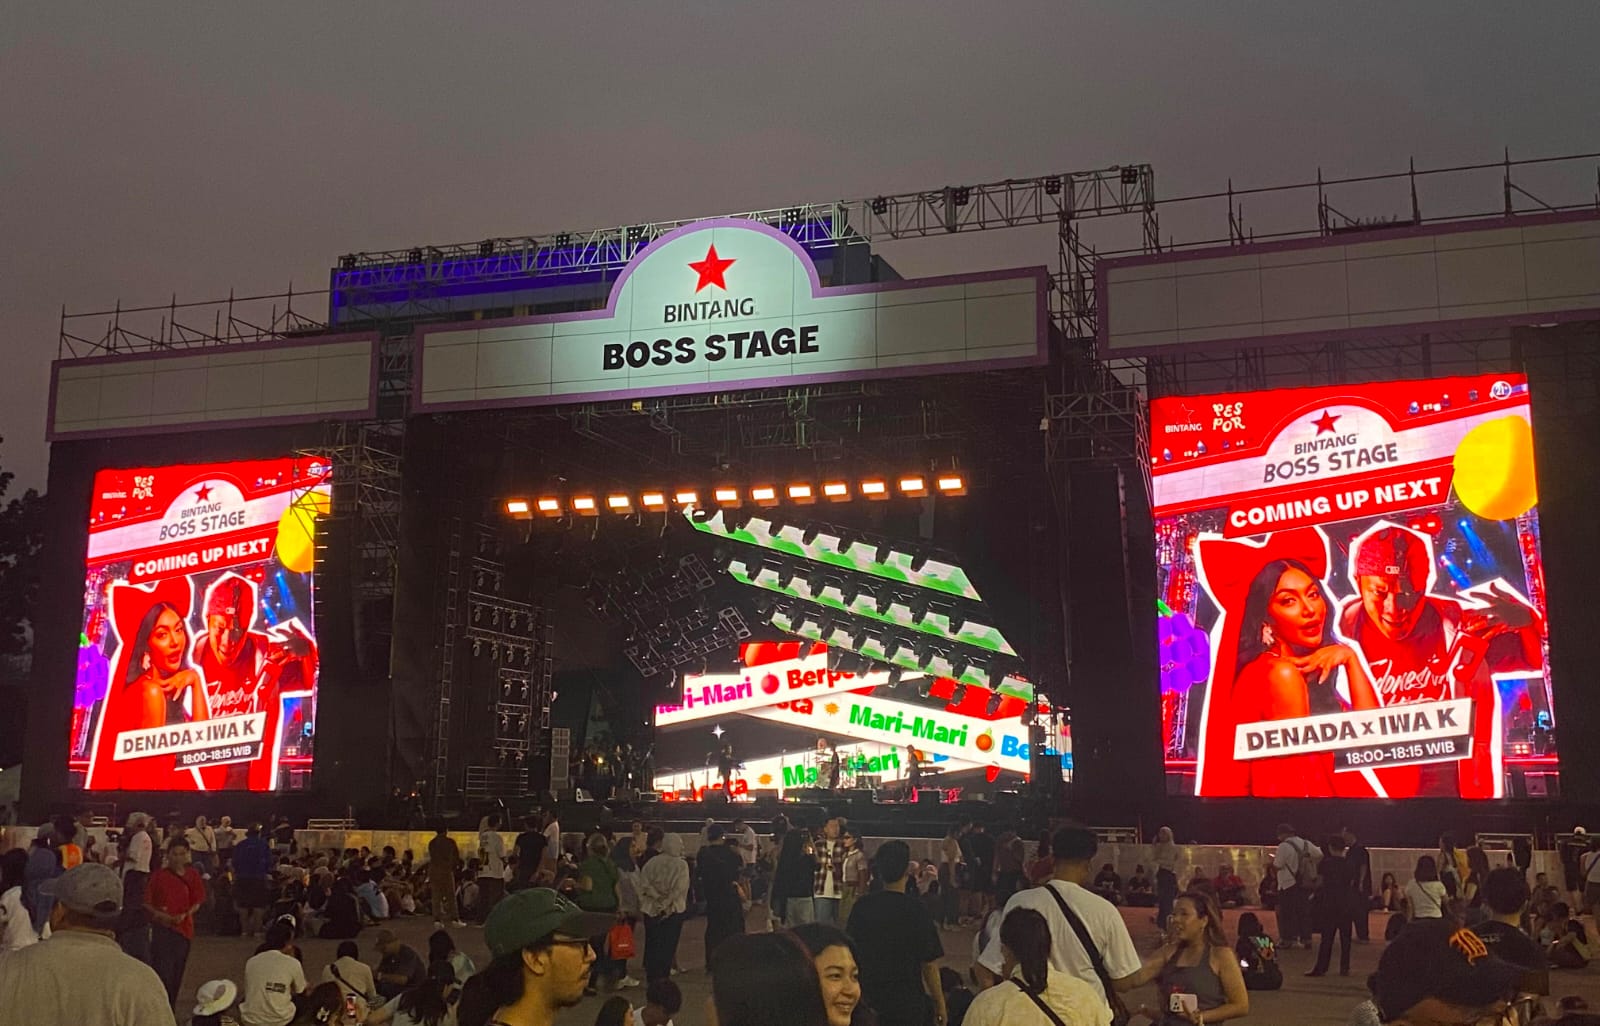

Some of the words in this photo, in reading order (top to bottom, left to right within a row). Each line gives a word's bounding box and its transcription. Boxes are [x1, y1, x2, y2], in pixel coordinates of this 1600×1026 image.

[664, 298, 755, 323] BINTANG
[603, 337, 696, 371] BOSS
[704, 325, 819, 362] STAGE
[1212, 402, 1244, 418] PES
[1165, 423, 1203, 433] BINTANG
[1212, 417, 1246, 432] POR
[1294, 433, 1357, 455] BINTANG
[1263, 456, 1320, 483] BOSS
[1329, 442, 1398, 471] STAGE
[132, 487, 154, 500] POR
[1230, 498, 1330, 528] COMING
[1336, 489, 1370, 511] UP
[1375, 477, 1441, 500] NEXT
[180, 502, 222, 519] BINTANG
[159, 523, 196, 541] BOSS
[201, 510, 245, 532] STAGE
[134, 552, 198, 576] COMING
[202, 547, 224, 563] UP
[226, 538, 270, 559] NEXT
[123, 731, 192, 754] DENADA
[206, 721, 239, 741] IWA
[242, 719, 256, 735] K
[849, 704, 969, 747] Mari-Mari
[1246, 720, 1357, 751] DENADA
[1378, 710, 1432, 736] IWA
[1437, 707, 1458, 729] K
[232, 746, 252, 757] WIB
[1427, 741, 1456, 756] WIB
